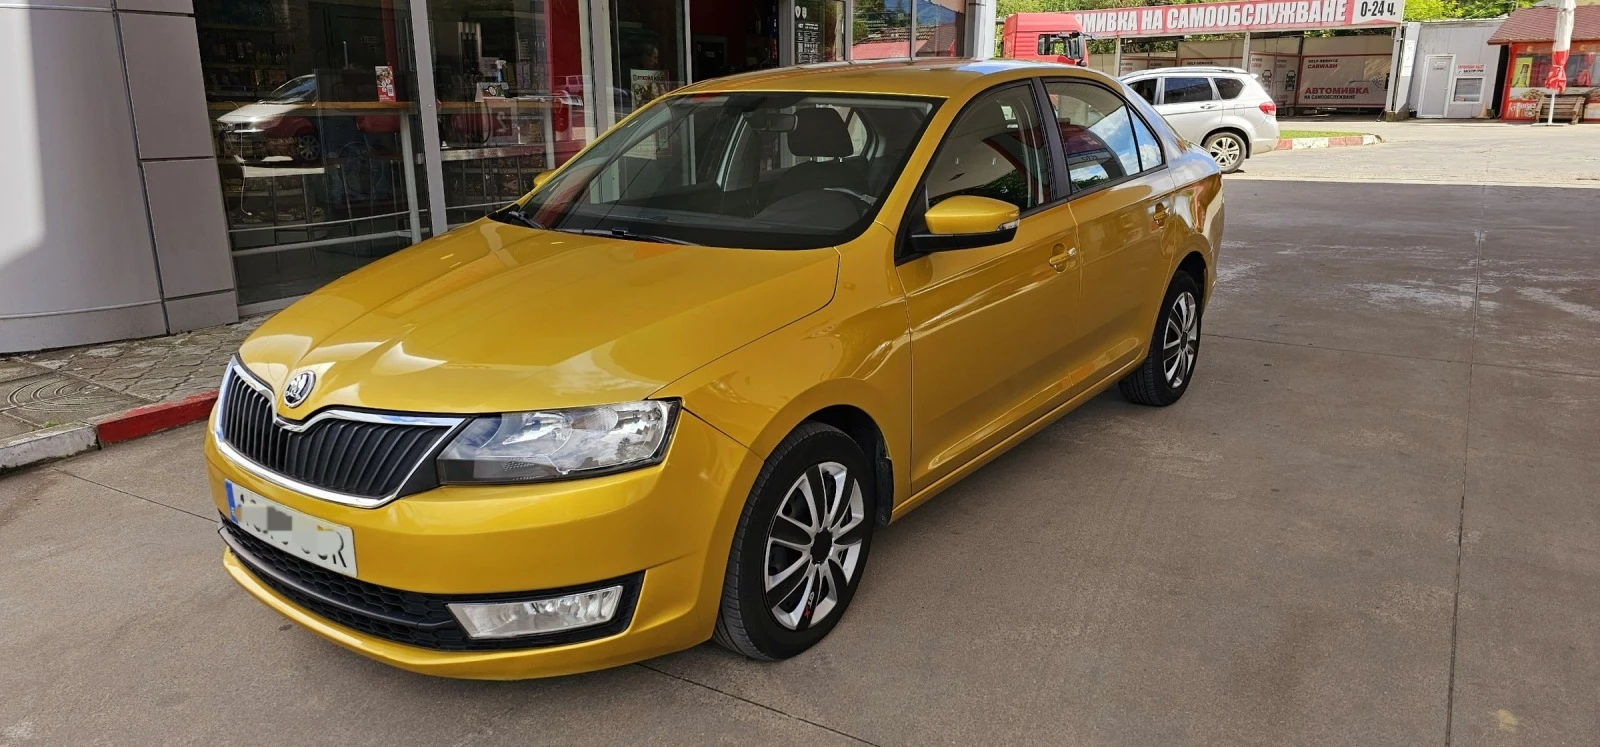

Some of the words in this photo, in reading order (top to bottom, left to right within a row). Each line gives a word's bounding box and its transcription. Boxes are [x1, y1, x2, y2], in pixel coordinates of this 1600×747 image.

[1141, 9, 1163, 30] НА
[1166, 0, 1347, 30] САМООБСЛУЖВАНЕ
[1360, 0, 1385, 17] 0-24
[1387, 2, 1396, 16] ч.
[1304, 87, 1370, 95] АВТОМИВКА
